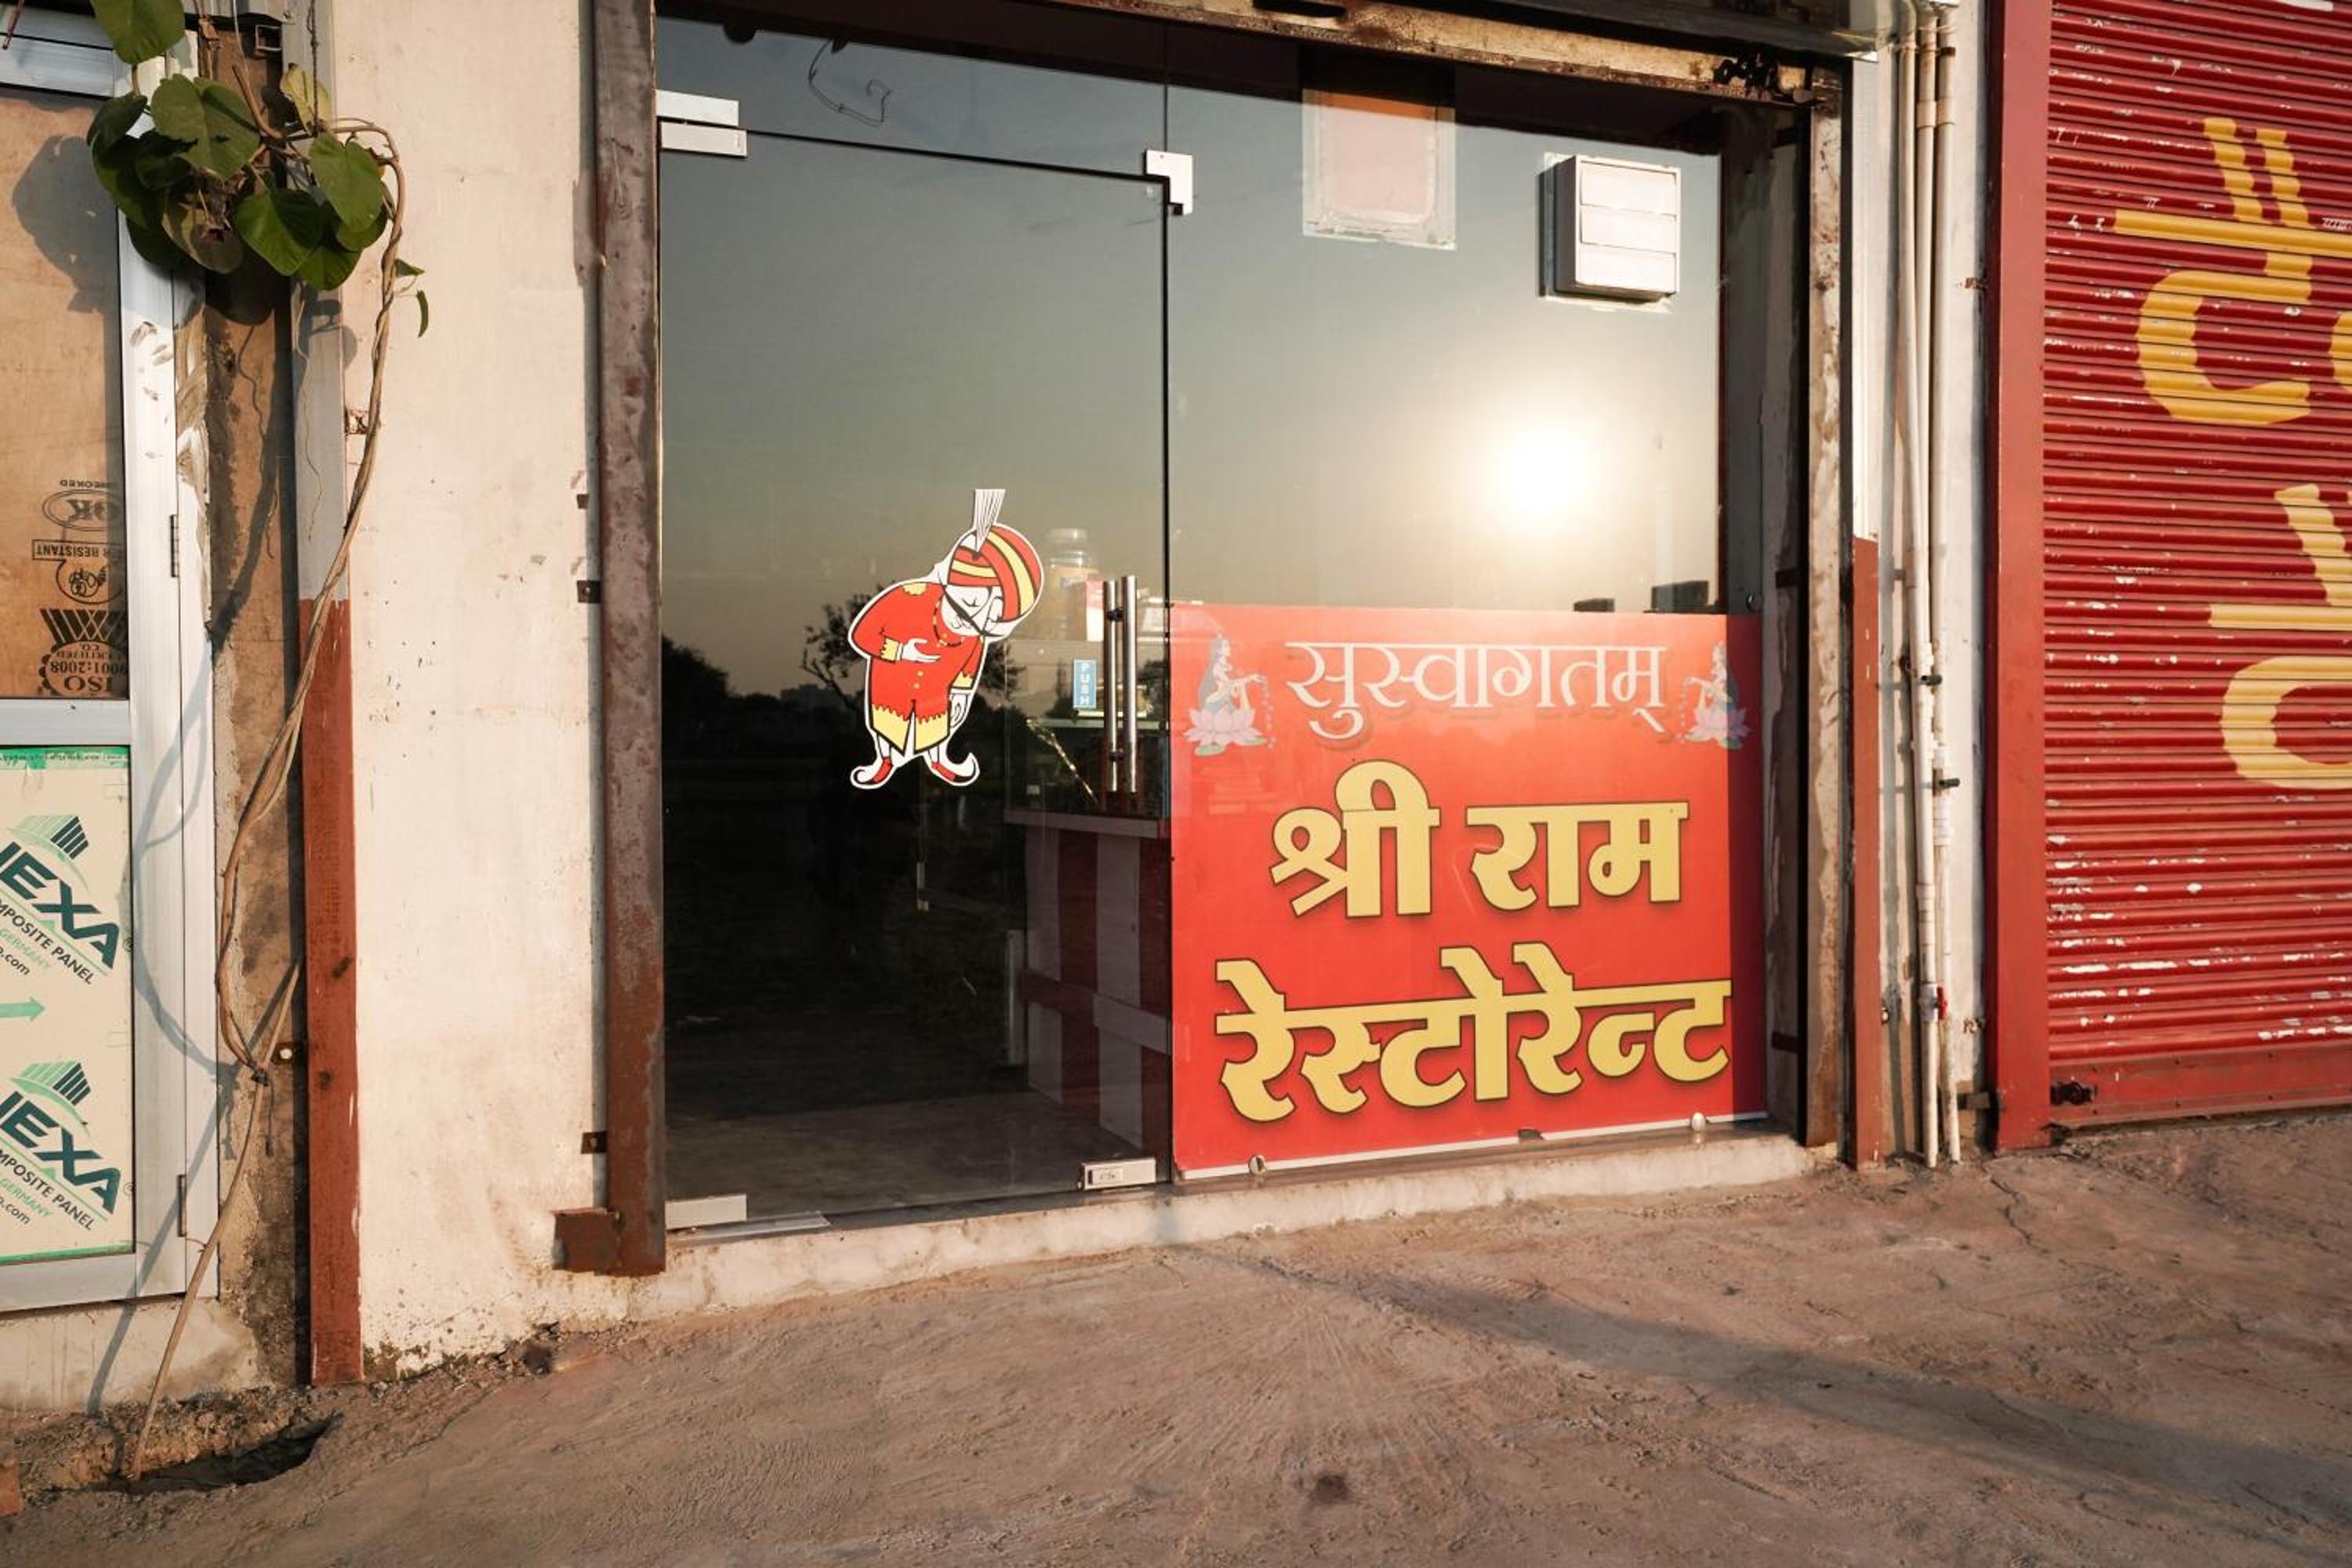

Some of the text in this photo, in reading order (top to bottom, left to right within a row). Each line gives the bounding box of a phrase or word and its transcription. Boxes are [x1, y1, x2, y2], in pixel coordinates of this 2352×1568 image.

[35, 544, 99, 557] RESISTANT
[64, 675, 113, 692] ISO
[1080, 662, 1091, 706] PUSH
[1285, 641, 1667, 739] सुस्वागतम्
[1270, 759, 1690, 918] श्री राम
[51, 946, 95, 985] PANEL
[1215, 941, 1733, 1123] रेस्टोरेन्ट
[52, 1193, 95, 1231] PANEL
